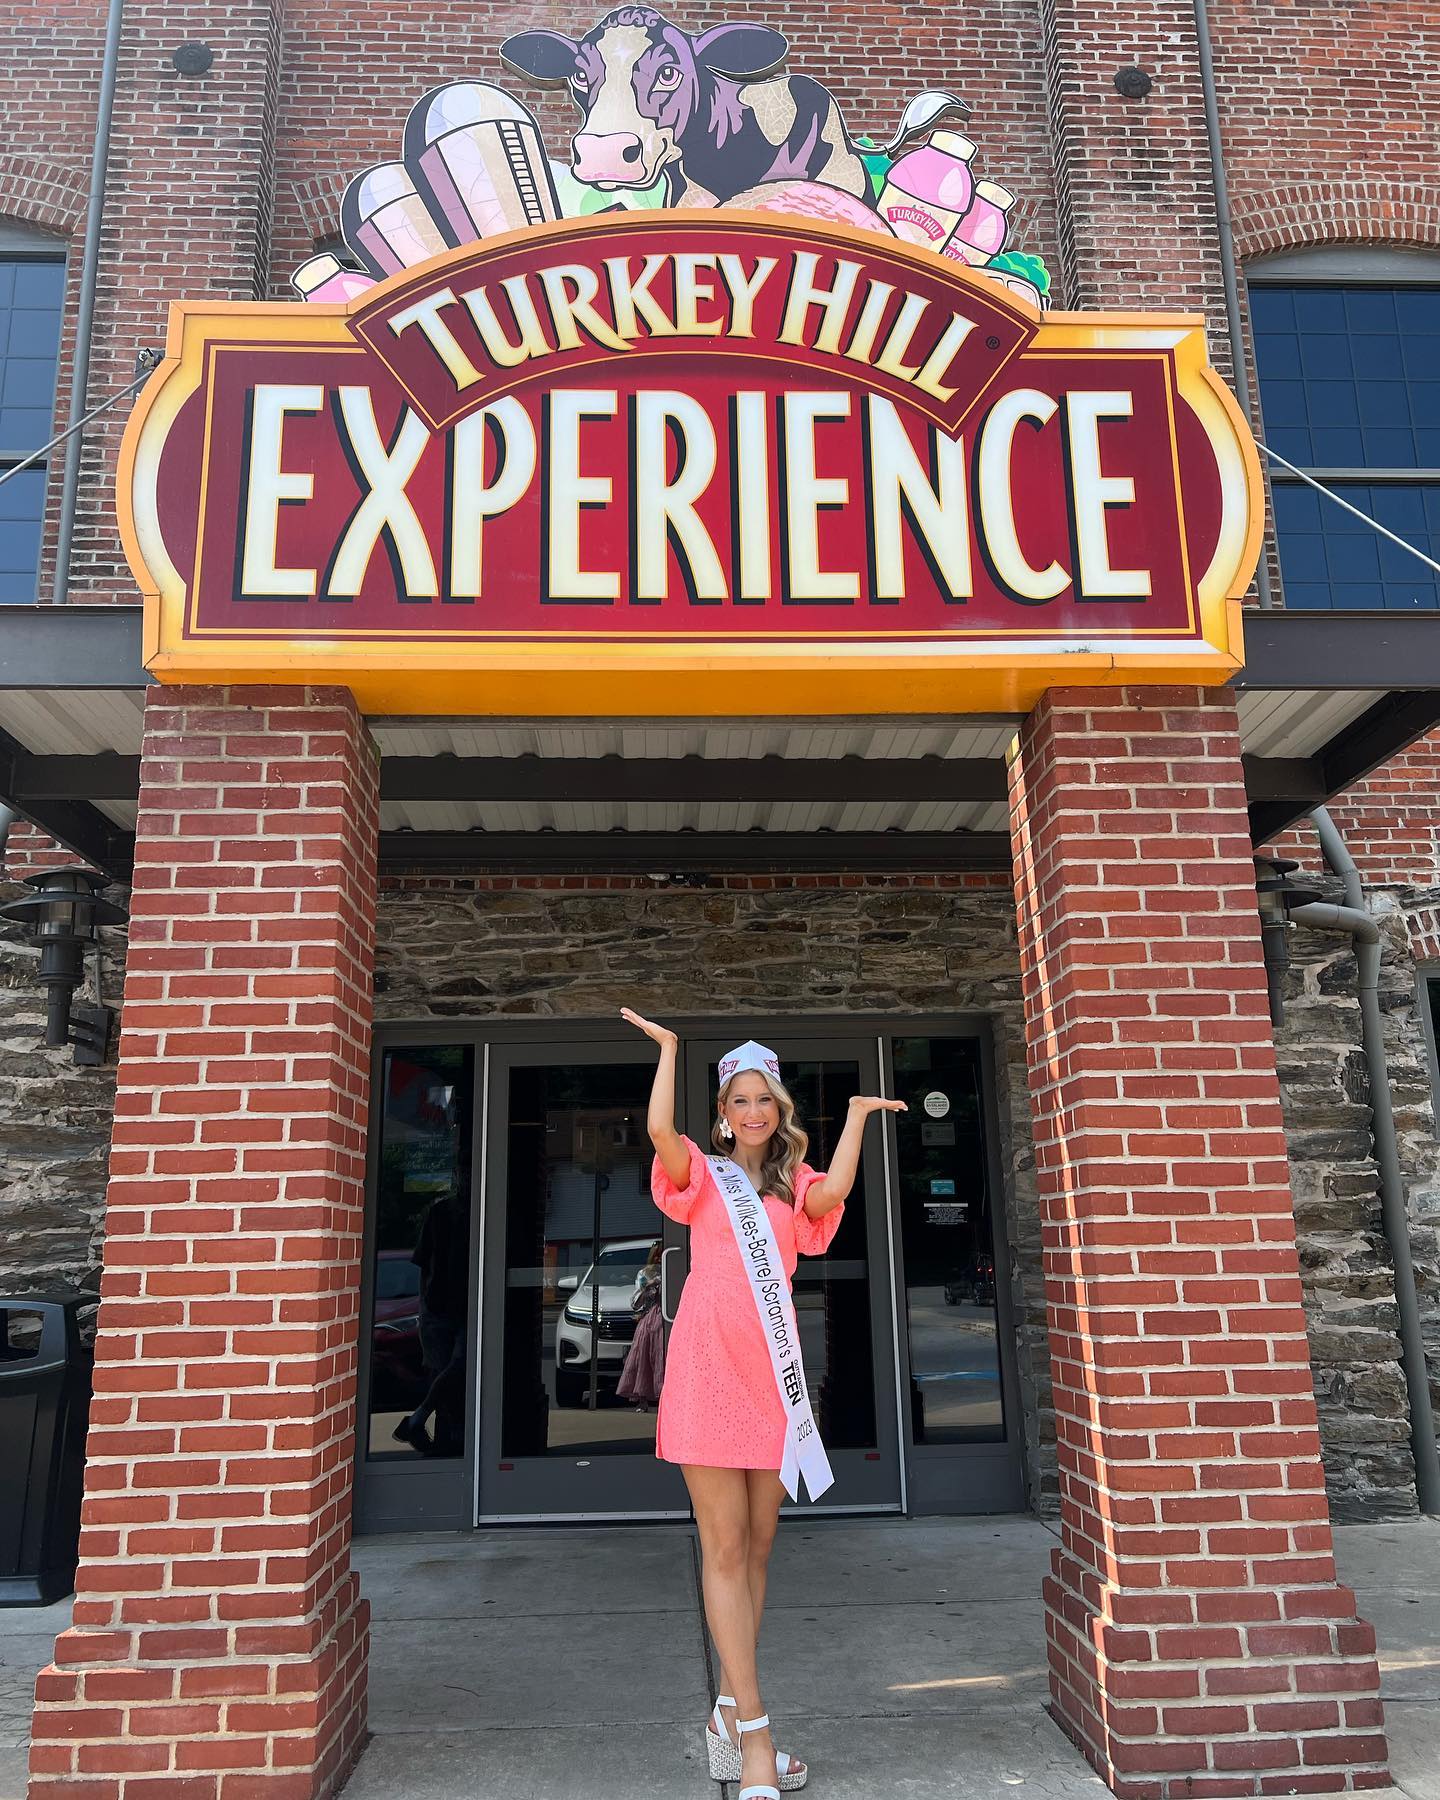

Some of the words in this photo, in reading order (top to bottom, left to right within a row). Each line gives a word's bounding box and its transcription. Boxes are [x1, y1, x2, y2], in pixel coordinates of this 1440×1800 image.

[891, 207, 927, 226] TURKEY
[924, 217, 941, 238] HILL
[387, 253, 779, 391] TURKEY
[775, 250, 979, 403] HILL
[237, 383, 1153, 603] EXPERIENCE
[720, 1174, 744, 1195] Miss
[733, 1194, 794, 1359] Wilkes-Barre/Scranton's
[782, 1361, 802, 1407] TEEN
[796, 1418, 813, 1443] 2023
